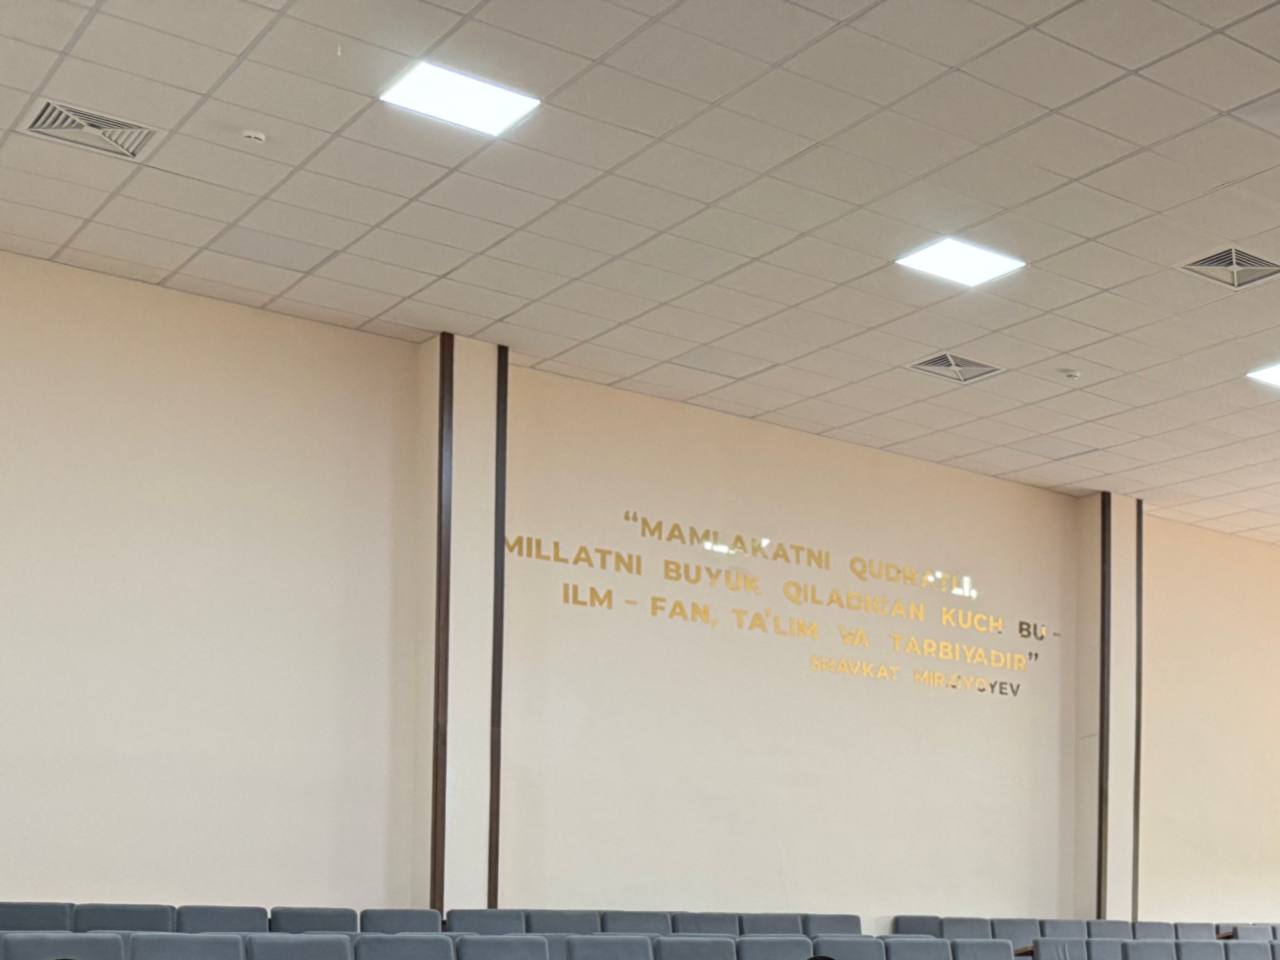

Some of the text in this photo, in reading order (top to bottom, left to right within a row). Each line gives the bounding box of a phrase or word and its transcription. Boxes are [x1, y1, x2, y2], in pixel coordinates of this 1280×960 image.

[504, 535, 642, 576] MILLATNI
[664, 559, 763, 596] BUYUK
[1018, 620, 1047, 641] BU
[562, 583, 613, 609] ILM
[838, 624, 871, 650] VA
